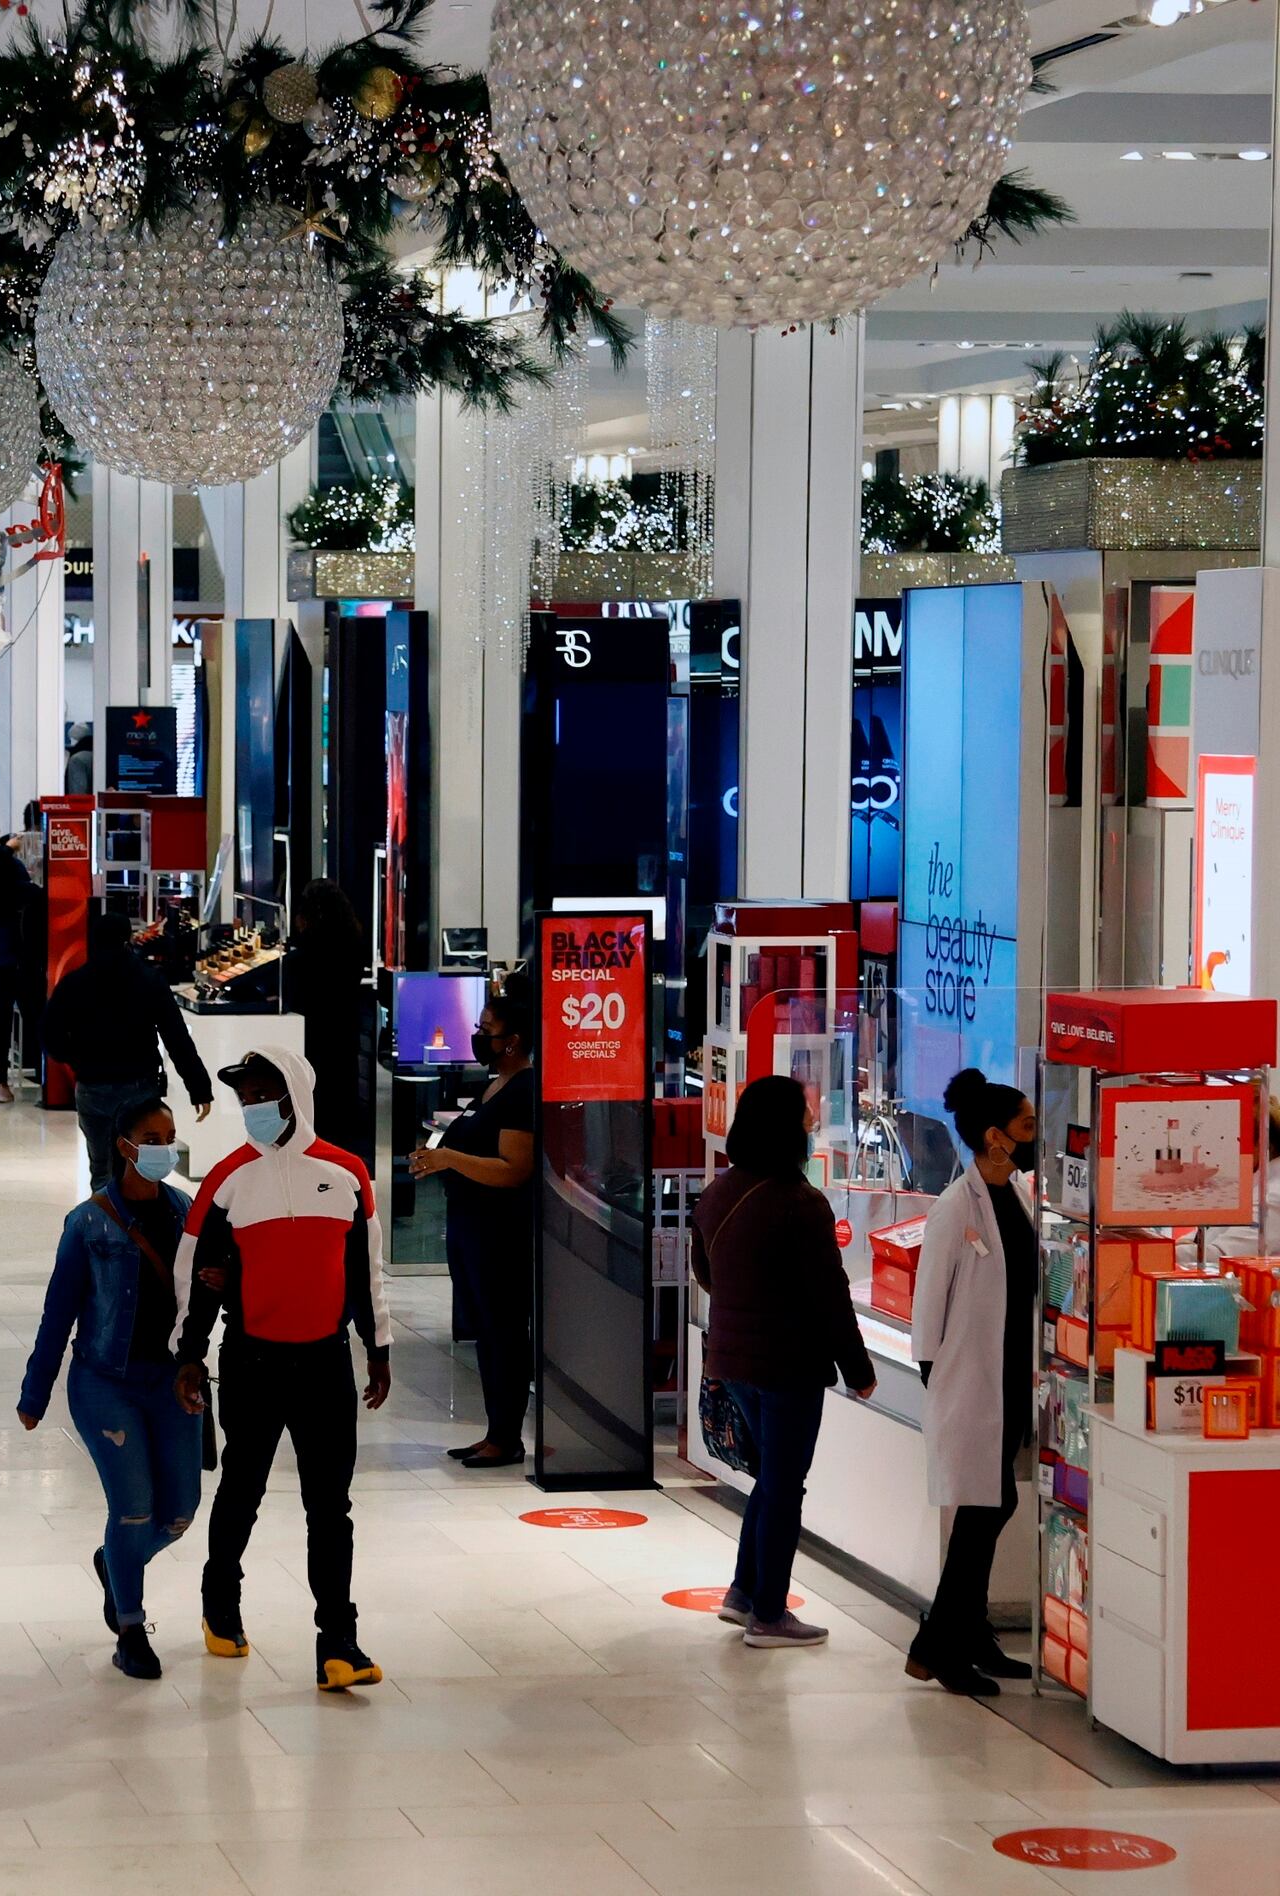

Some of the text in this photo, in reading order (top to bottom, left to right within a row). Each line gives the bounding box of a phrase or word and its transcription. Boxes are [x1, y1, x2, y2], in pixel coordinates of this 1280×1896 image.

[1198, 648, 1256, 681] CLINIQUE
[1215, 797, 1240, 820] Merry
[1210, 819, 1246, 842] Clinique
[927, 841, 954, 898] the
[550, 931, 636, 950] BLACK
[925, 898, 997, 987] beauty
[550, 950, 636, 969] FRIDAY
[551, 968, 615, 982] SPECIAL
[925, 958, 977, 1022] store
[561, 992, 626, 1030] $20
[567, 1041, 621, 1050] COSMETICS
[1067, 1024, 1086, 1038] LOVE.
[1086, 1027, 1116, 1044] BELIEVE.
[572, 1050, 617, 1059] SPECIALS
